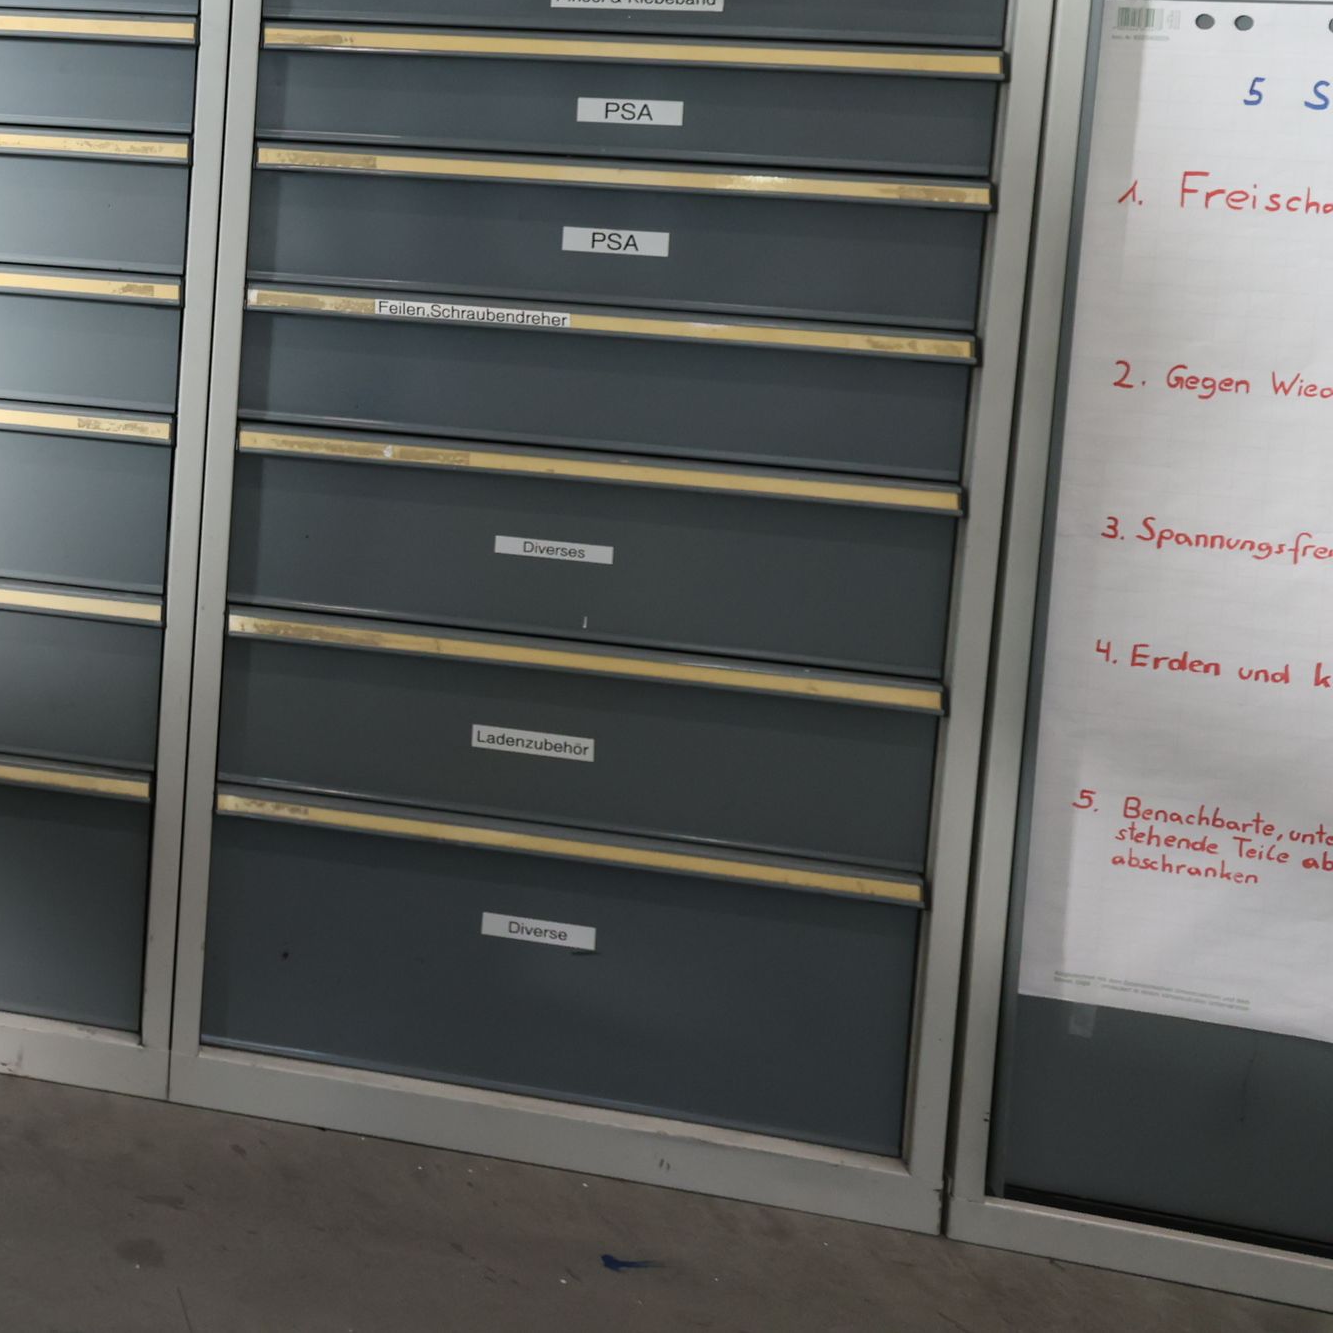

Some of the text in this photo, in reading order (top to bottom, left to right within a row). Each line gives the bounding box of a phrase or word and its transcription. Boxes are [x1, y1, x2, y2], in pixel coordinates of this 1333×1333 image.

[1243, 77, 1265, 106] 5
[604, 103, 653, 120] PSA
[591, 232, 639, 251] PSA
[1112, 360, 1146, 388] 2.
[1166, 364, 1250, 398] Gegen
[1101, 516, 1125, 541] 3.
[522, 542, 585, 558] Diverses
[1095, 640, 1118, 665] 4.
[1130, 645, 1219, 676] Erden
[1238, 665, 1289, 684] und
[476, 730, 589, 756] Ladenzubehör
[1072, 789, 1098, 813] 5.
[1115, 823, 1218, 856] stehende
[1233, 836, 1289, 864] Teile
[1112, 851, 1258, 885] abschranken
[508, 921, 568, 942] Diverse
